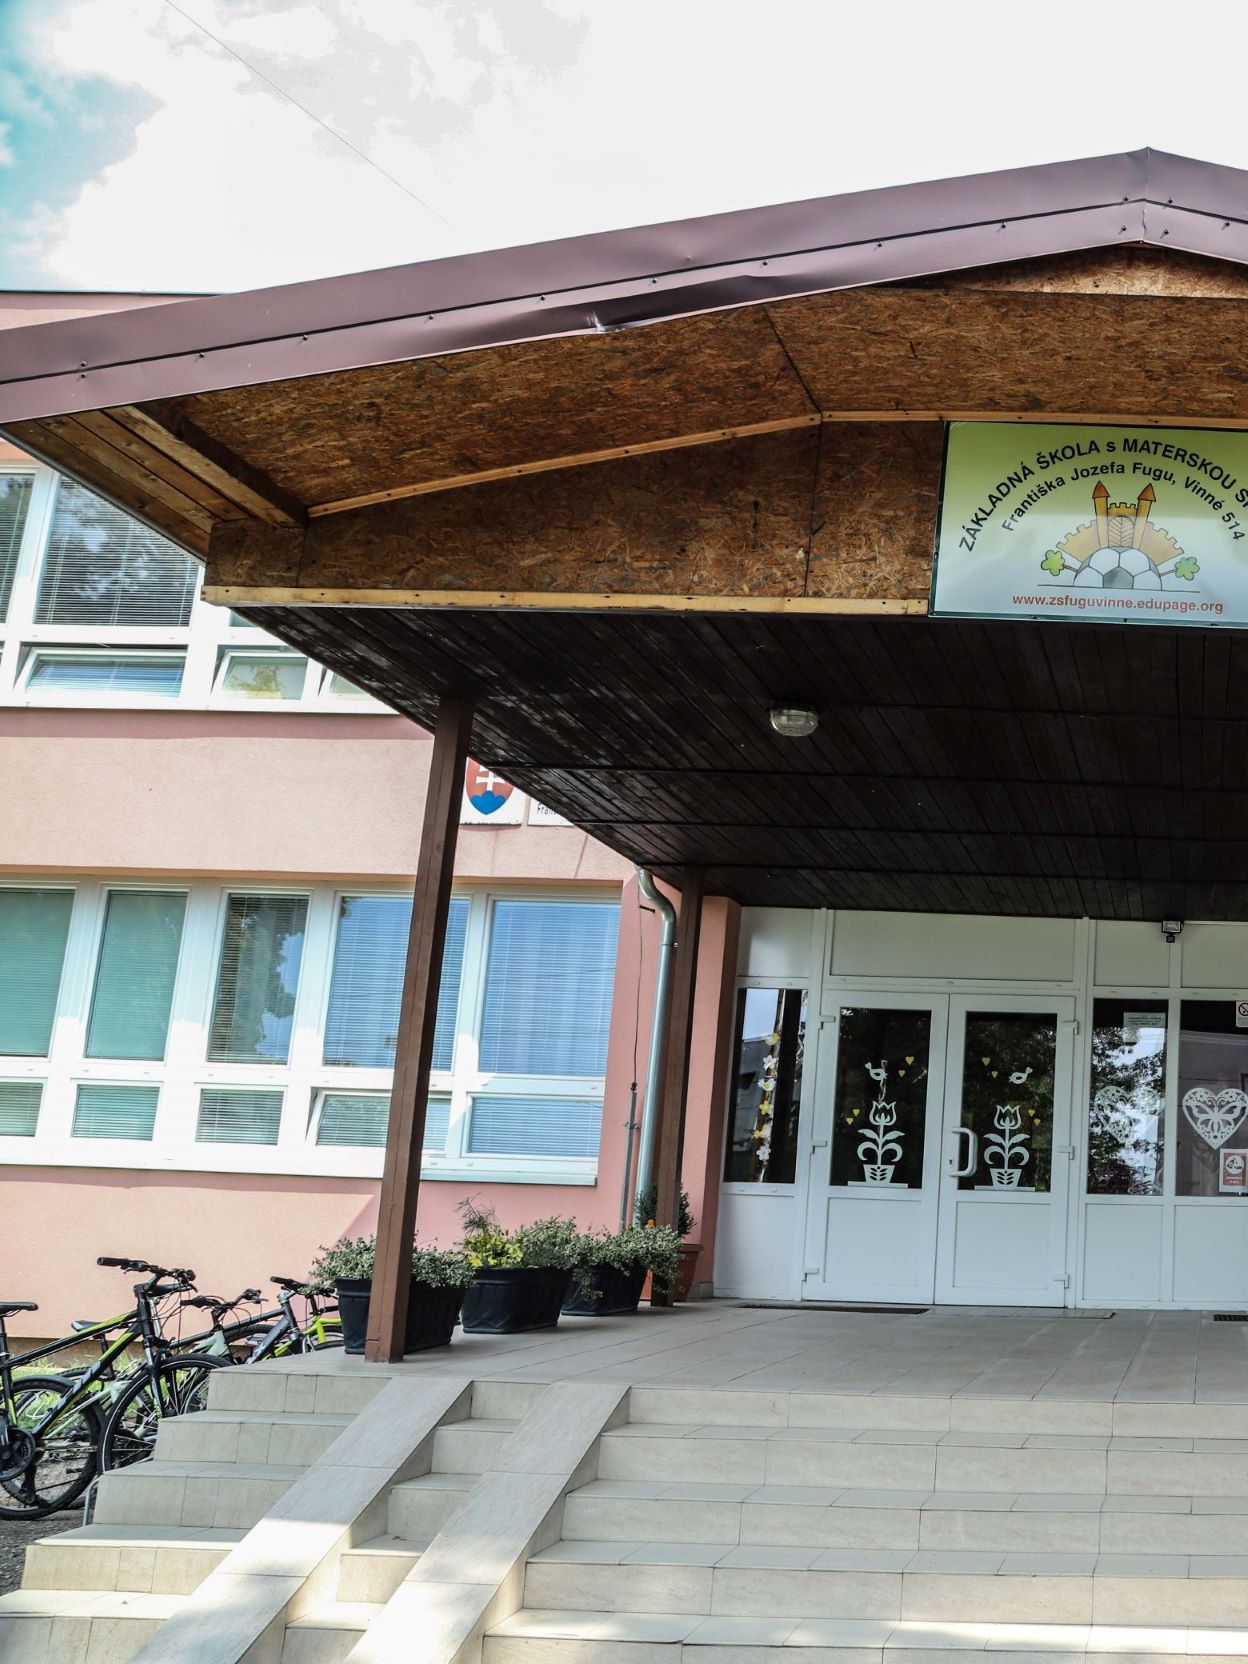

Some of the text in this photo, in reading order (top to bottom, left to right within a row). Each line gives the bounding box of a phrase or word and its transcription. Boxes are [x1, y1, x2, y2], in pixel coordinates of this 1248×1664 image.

[958, 460, 1036, 552] ZÁKLADNÁ
[1035, 440, 1101, 470] ŠKOLA
[1105, 440, 1117, 453] s
[1122, 438, 1237, 490] MATERSKOU
[1001, 461, 1246, 541] Františka Jozefa Fugu, Vinné 514
[1012, 594, 1224, 615] www.zsfuguvinne.edupage.org
